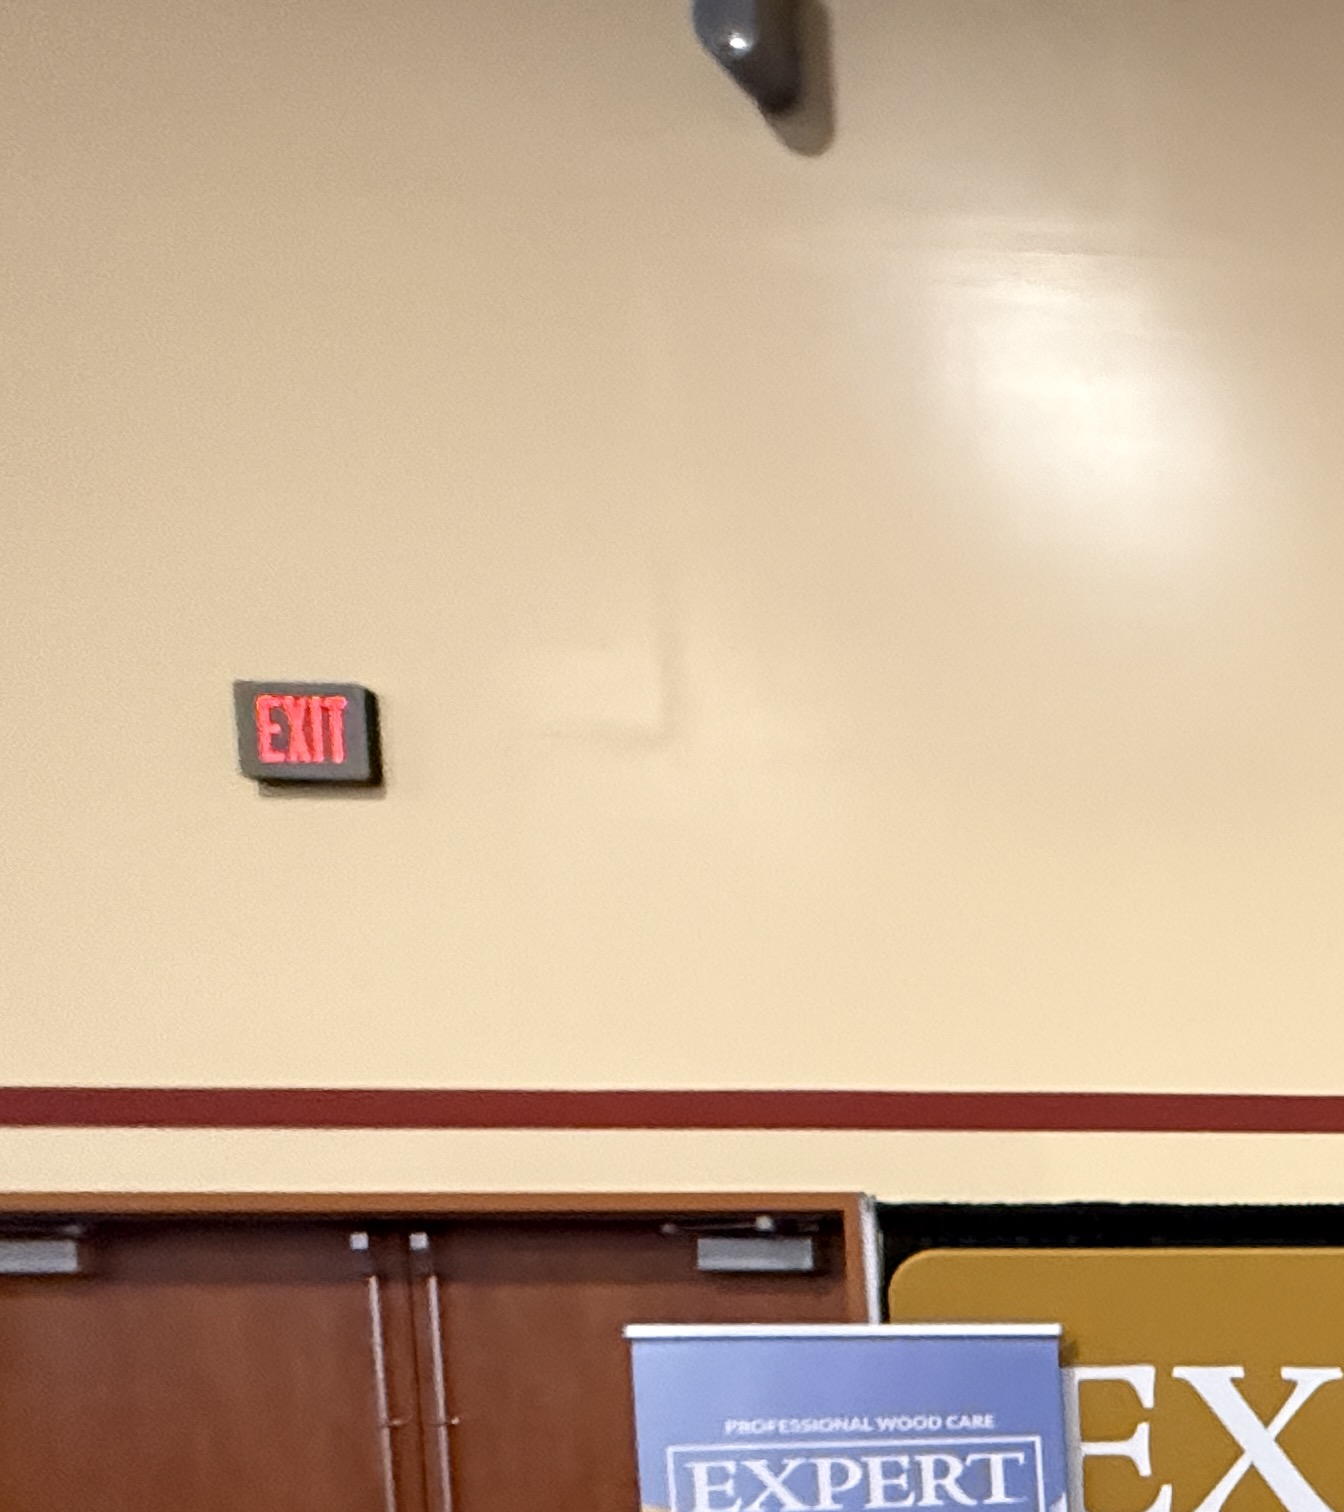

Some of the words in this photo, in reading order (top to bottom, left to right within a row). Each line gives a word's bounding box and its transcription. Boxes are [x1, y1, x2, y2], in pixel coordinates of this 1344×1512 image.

[255, 694, 347, 764] EXIT
[724, 1416, 873, 1435] PROFESSIONAL
[875, 1415, 943, 1432] WOOD
[946, 1413, 995, 1430] CARE
